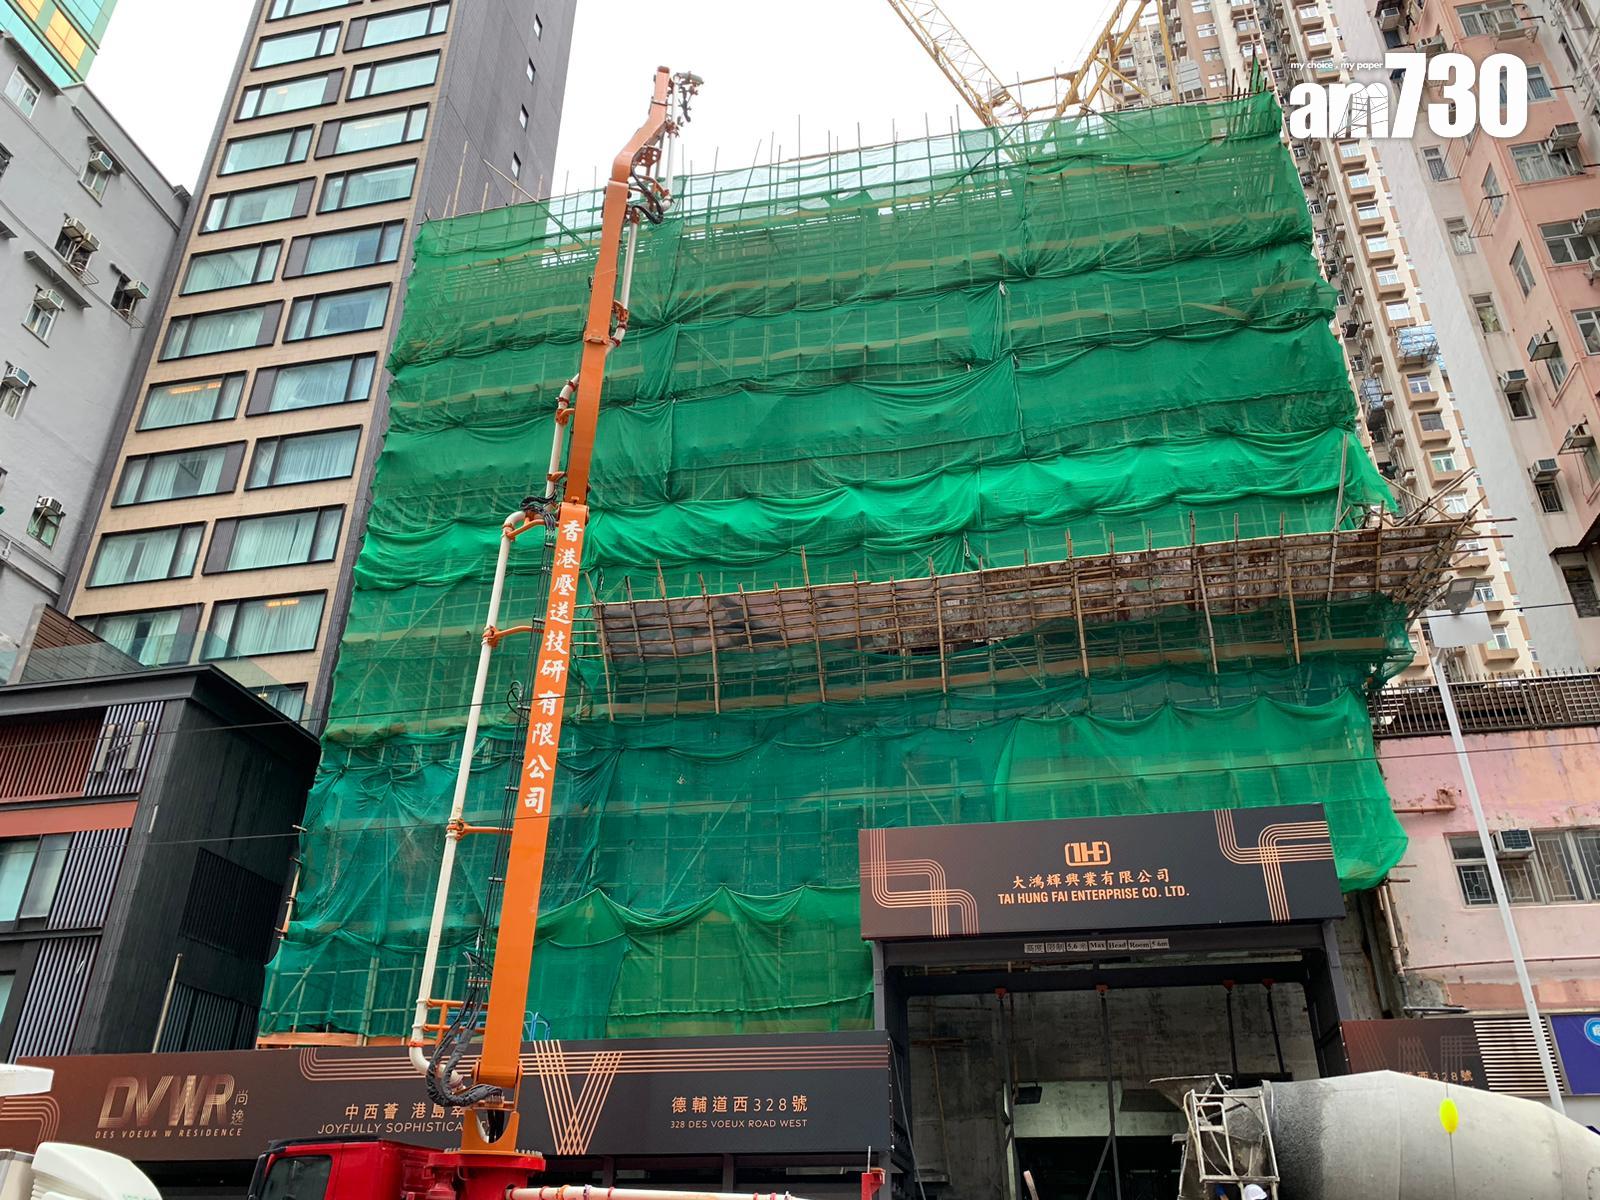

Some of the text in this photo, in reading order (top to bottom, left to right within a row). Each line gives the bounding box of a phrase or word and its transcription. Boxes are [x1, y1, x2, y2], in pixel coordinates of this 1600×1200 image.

[524, 519, 583, 815] 香港壓送技研有限公司
[1012, 868, 1170, 890] 大鴻輝興業有限公司
[997, 885, 1190, 905] TAI HUNG FAI ENTERPRISE CO. LTD.
[97, 1074, 235, 1129] DVWR
[230, 1088, 249, 1126] 尚逸
[671, 1094, 808, 1113] 德輔道西328號
[95, 1128, 243, 1139] DES VOEUX W RESIDENCE
[317, 1123, 382, 1135] JOYFULLY
[670, 1119, 808, 1129] 328 DES VOEUX ROAD WEST
